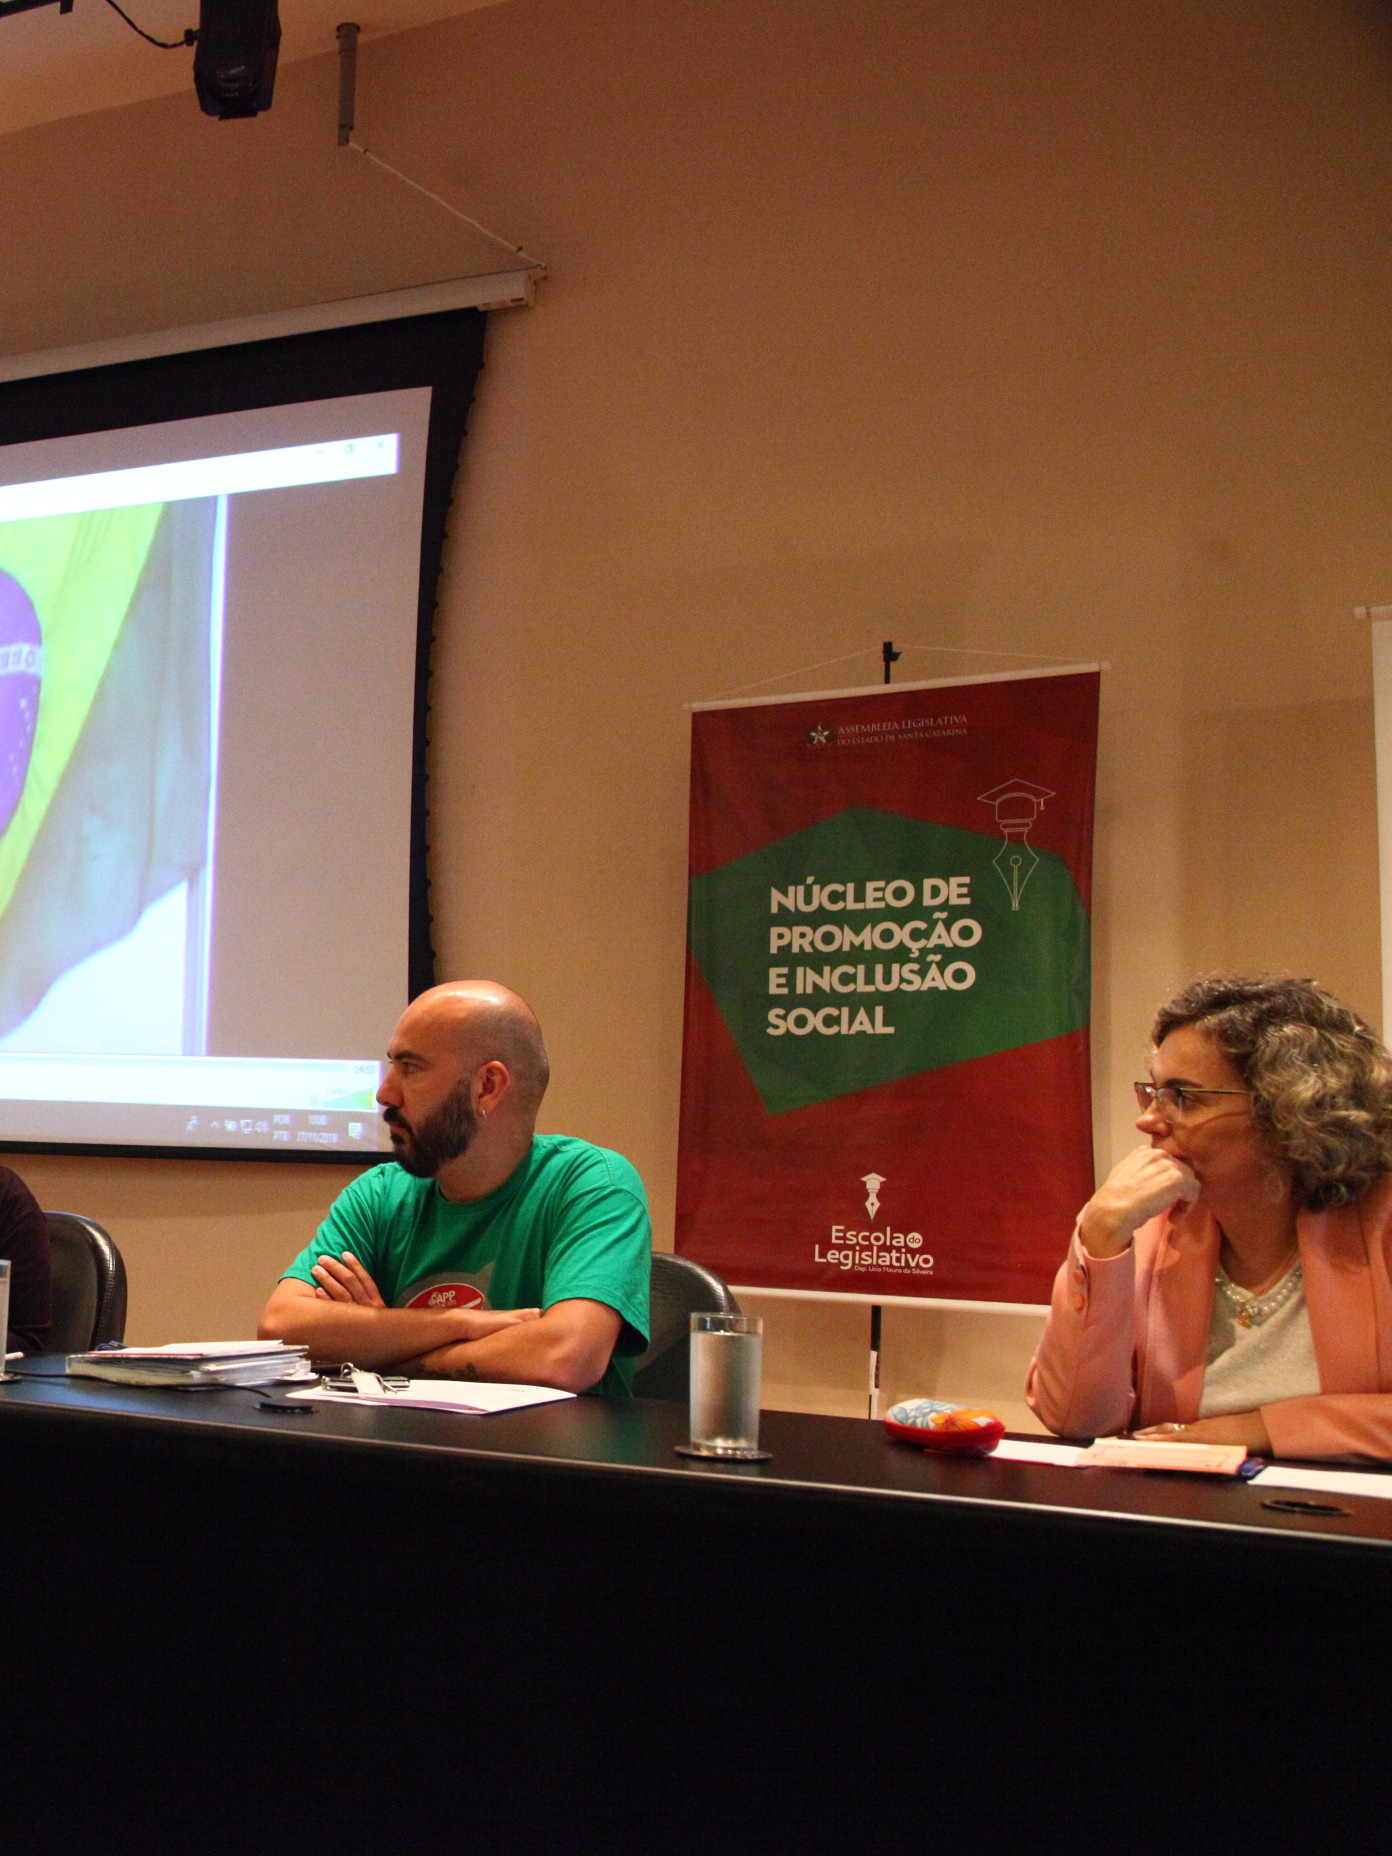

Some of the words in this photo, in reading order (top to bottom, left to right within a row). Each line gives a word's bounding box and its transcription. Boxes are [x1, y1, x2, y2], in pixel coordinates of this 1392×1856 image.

[838, 721, 899, 735] ASSEMBLEIA
[902, 715, 968, 729] LEGISLATIVA
[898, 731, 925, 741] SANTA
[925, 728, 968, 738] CATARINA
[770, 876, 915, 914] NÚCLEO
[922, 876, 971, 906] DE
[770, 911, 983, 958] PROMOÇÃO
[768, 967, 789, 995] E
[796, 954, 976, 994] INCLUSÃO
[766, 1005, 895, 1036] SOCIAL
[831, 1225, 904, 1247] Escola
[909, 1235, 920, 1244] do
[814, 1244, 934, 1270] Legislativo
